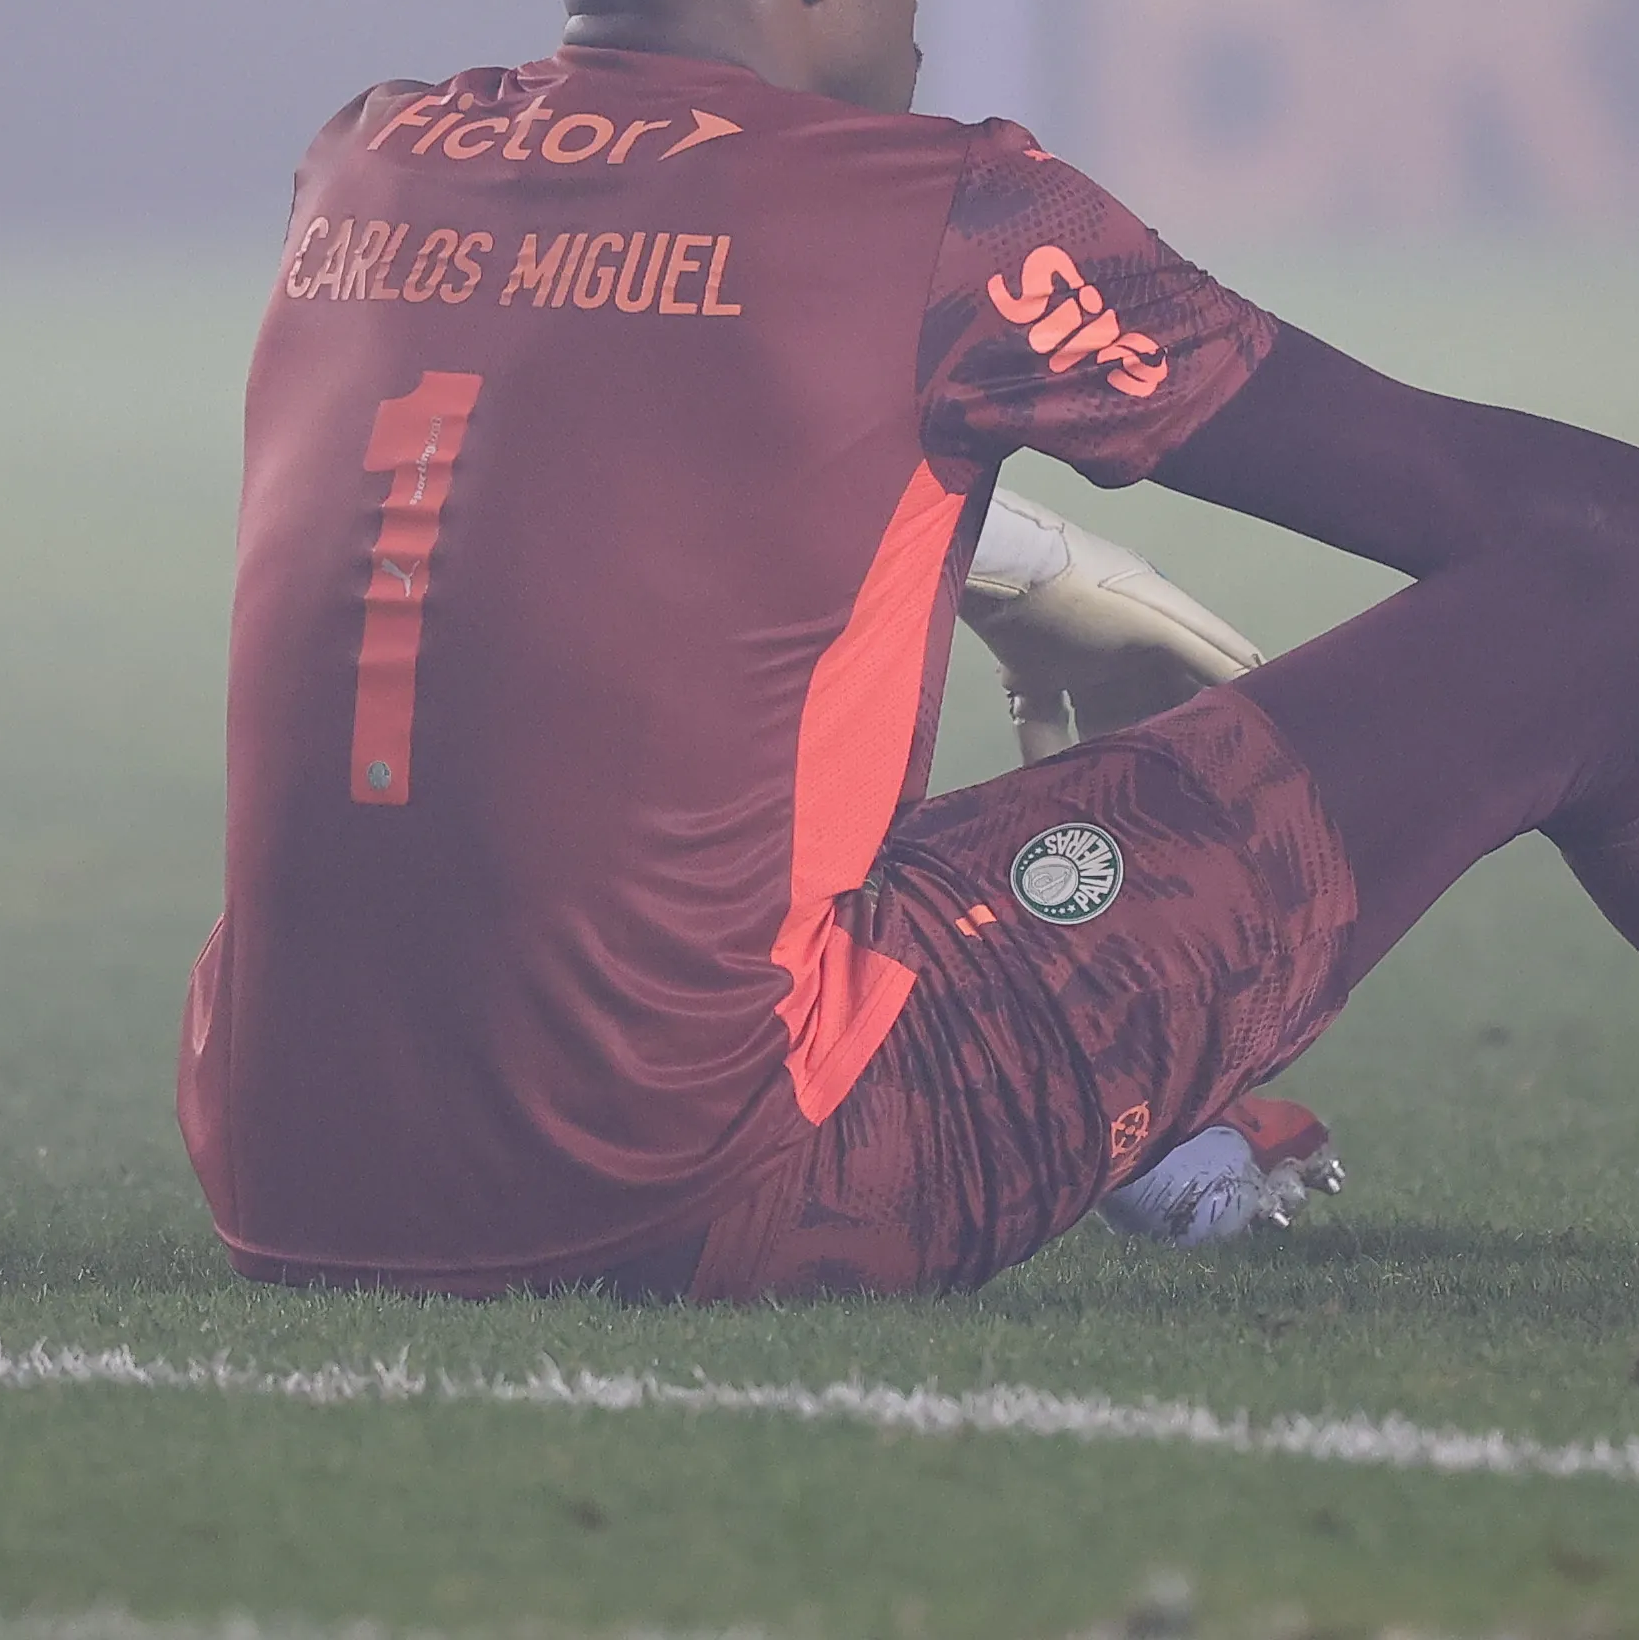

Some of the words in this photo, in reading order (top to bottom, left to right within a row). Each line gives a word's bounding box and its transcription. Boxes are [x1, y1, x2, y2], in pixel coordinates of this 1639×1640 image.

[367, 93, 671, 165] Fictor
[286, 216, 494, 304] CARLOS
[499, 232, 741, 316] MIGUEL
[351, 370, 484, 804] 1
[1044, 829, 1115, 912] PALMEIRAS
